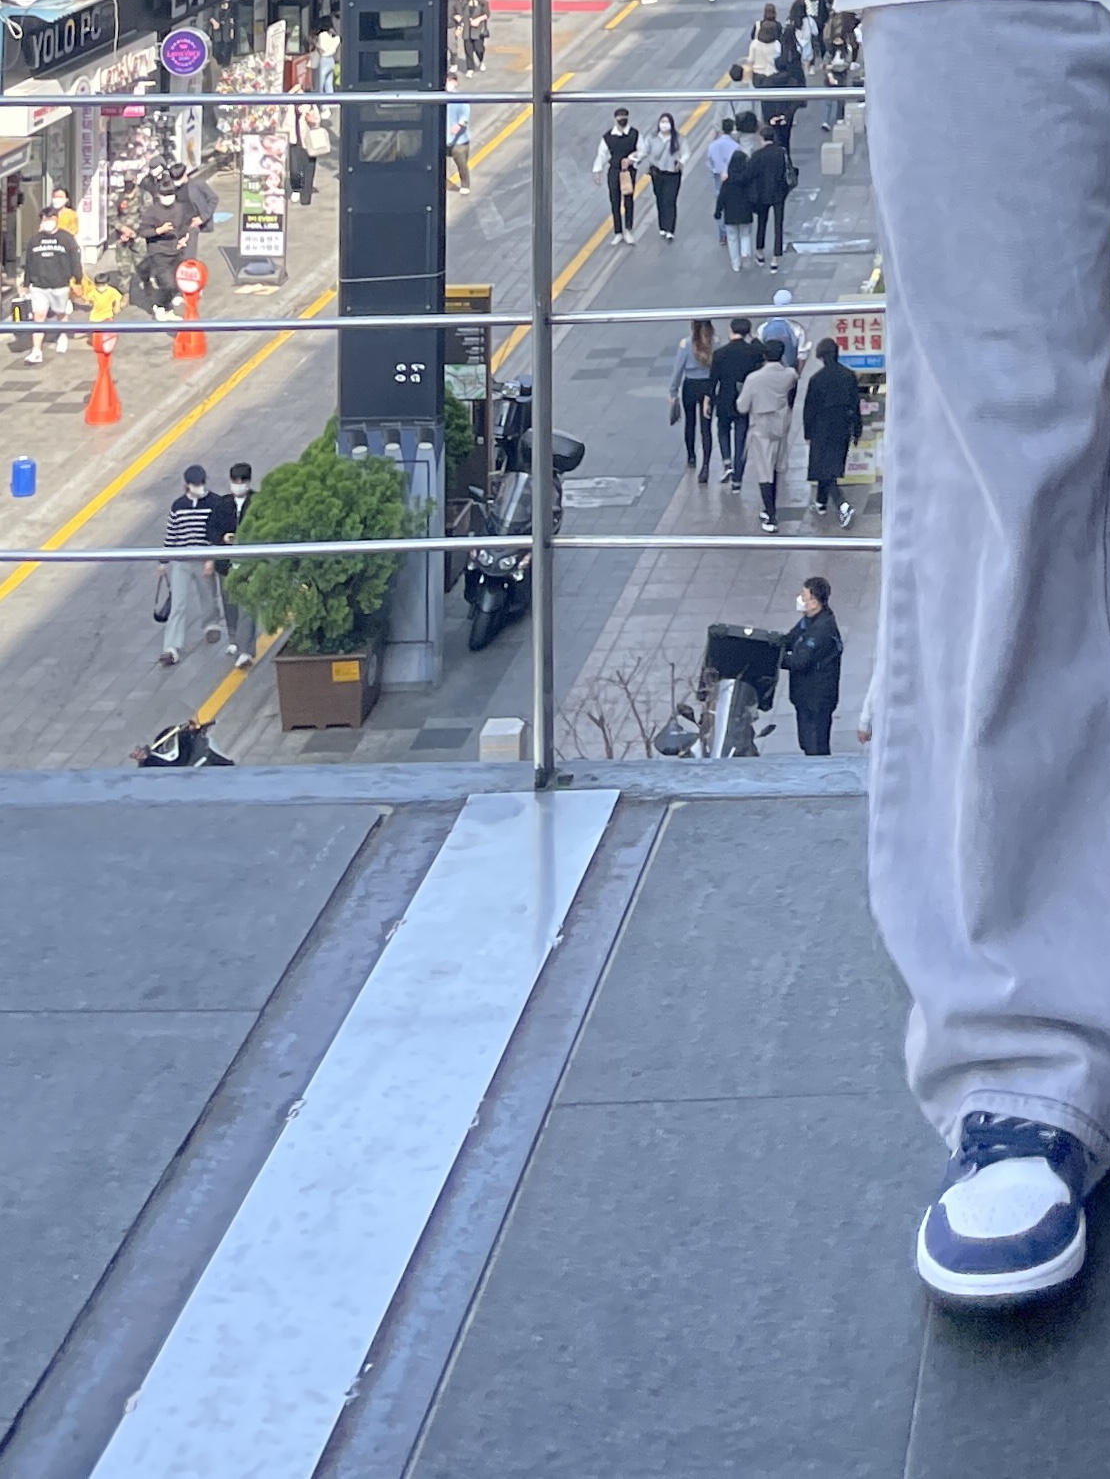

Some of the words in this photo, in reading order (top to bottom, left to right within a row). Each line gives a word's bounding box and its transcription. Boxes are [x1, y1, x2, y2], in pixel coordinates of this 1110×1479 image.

[32, 18, 76, 69] YOLO
[80, 6, 102, 48] PC
[835, 318, 882, 333] 쥬디스
